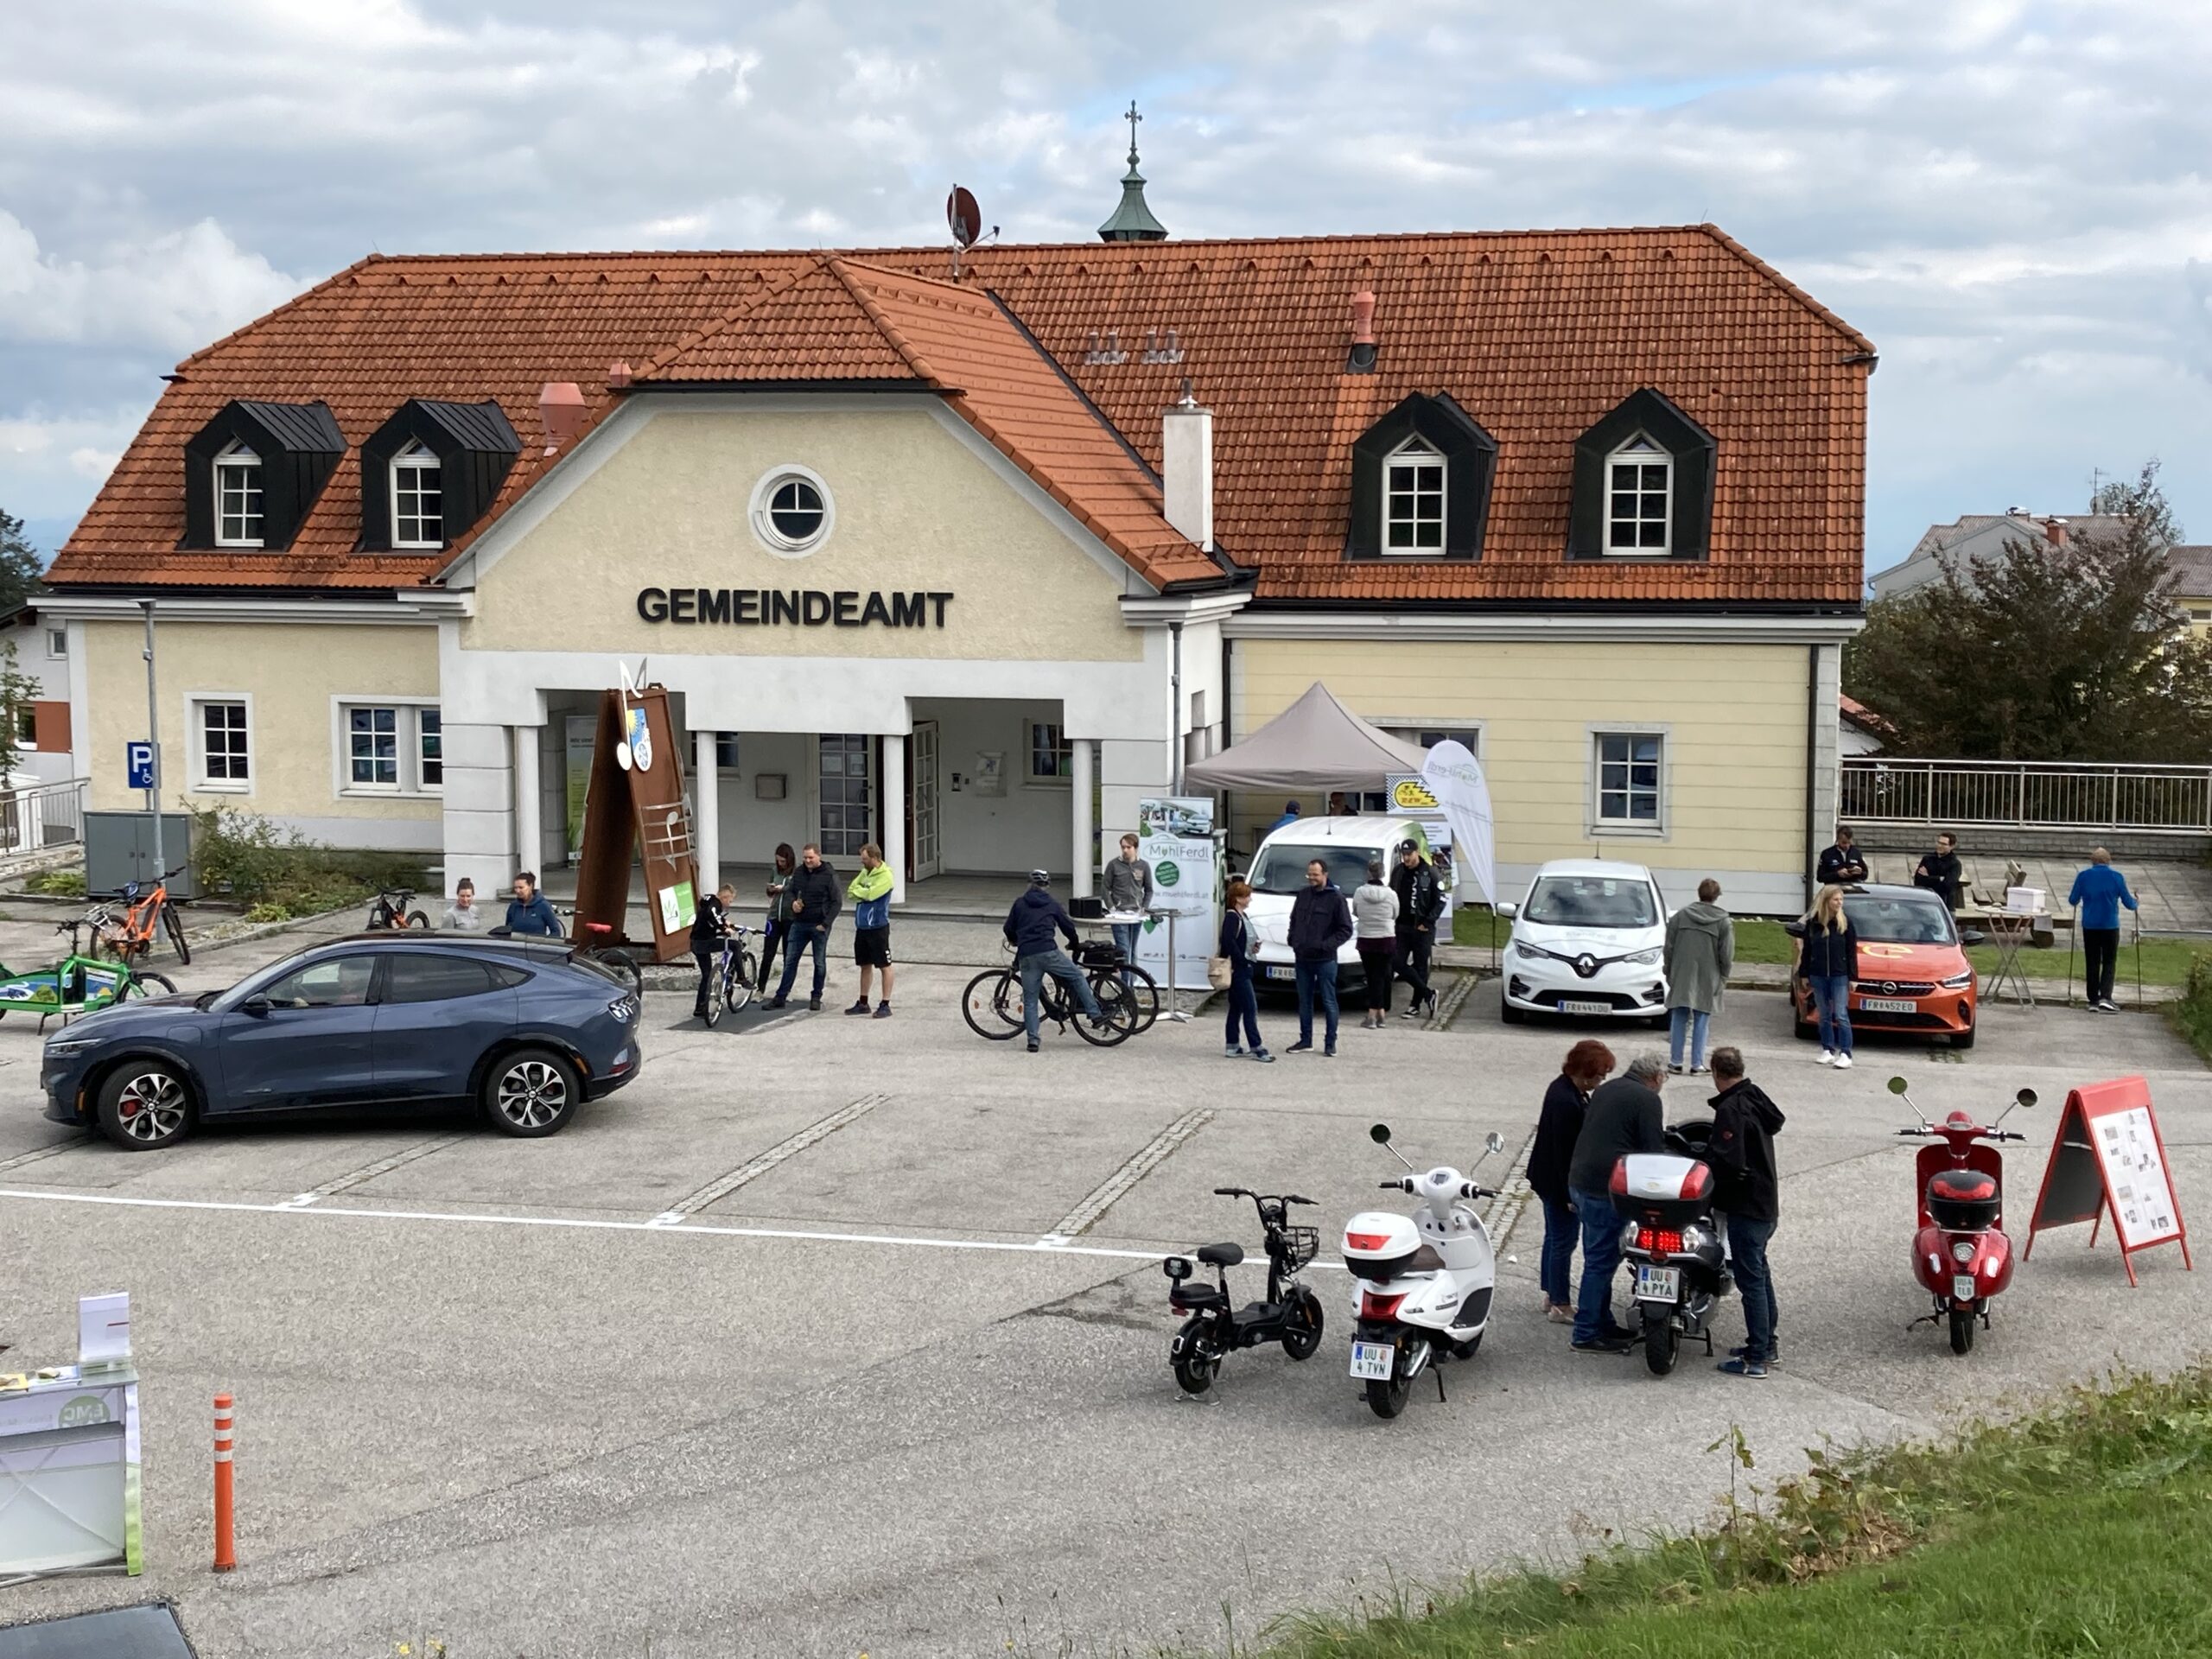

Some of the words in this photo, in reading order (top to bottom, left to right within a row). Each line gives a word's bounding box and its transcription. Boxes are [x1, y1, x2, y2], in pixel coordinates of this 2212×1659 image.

[638, 588, 954, 627] GEMEINDEAMT
[132, 746, 153, 773] P
[1867, 1001, 1878, 1010] FR
[1650, 1269, 1663, 1281] UU
[1643, 1282, 1648, 1294] 4
[1652, 1283, 1673, 1296] PYA
[1363, 1348, 1377, 1361] UU
[1357, 1361, 1363, 1373] 4
